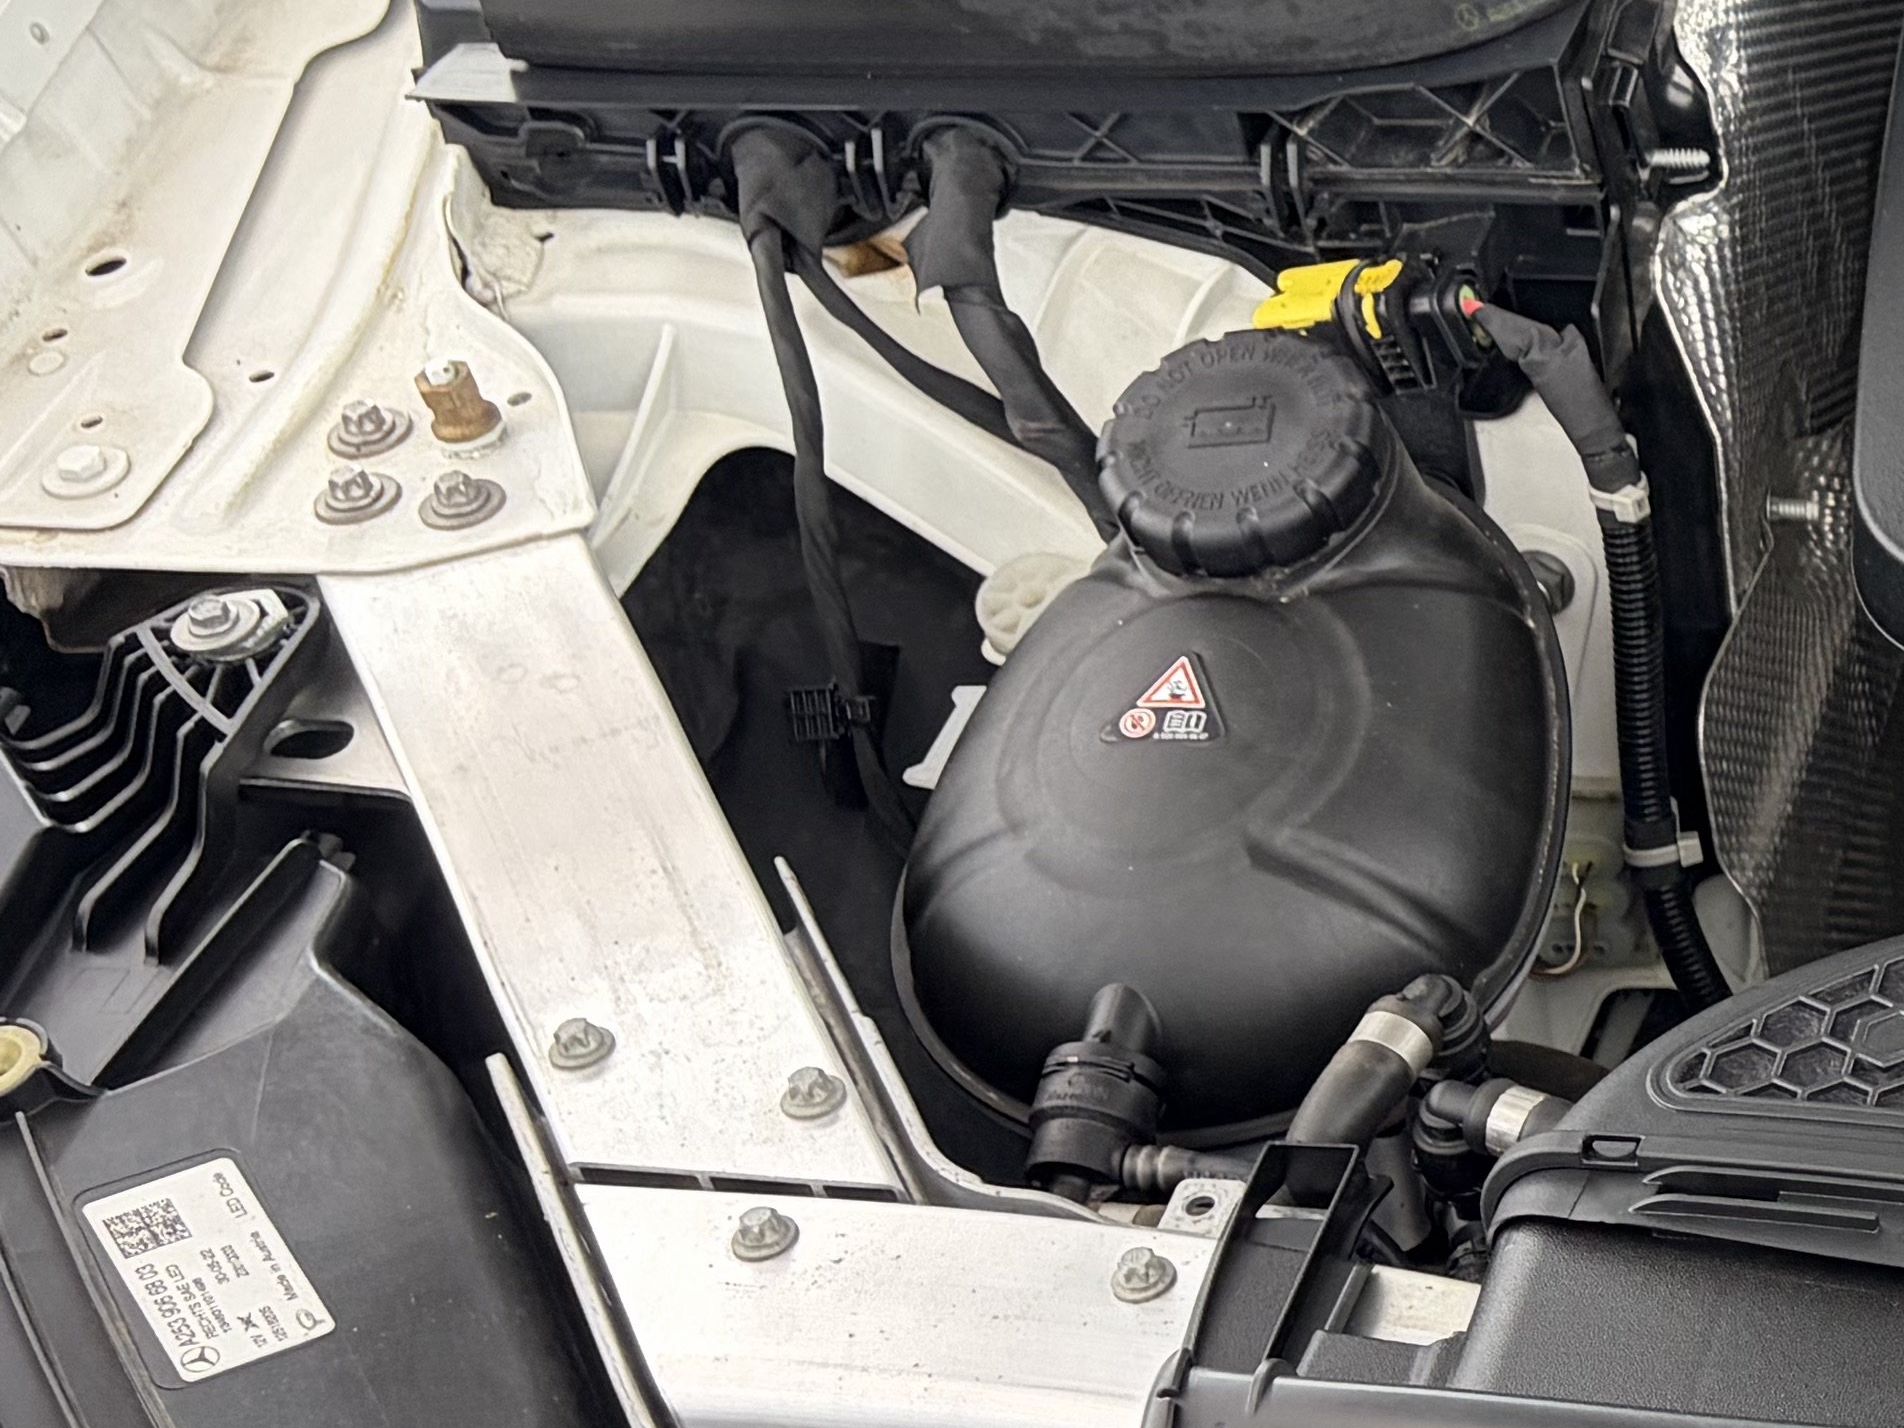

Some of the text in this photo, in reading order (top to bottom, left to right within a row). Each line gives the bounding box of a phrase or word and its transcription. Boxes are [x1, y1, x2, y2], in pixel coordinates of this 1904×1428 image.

[1134, 392, 1161, 420] DO
[1156, 362, 1192, 395] NOT
[1200, 345, 1256, 367] OPEN
[1231, 474, 1291, 507] WENN
[213, 1172, 234, 1198] Code
[226, 1198, 248, 1218] LED
[250, 1231, 298, 1301] Made in Austria
[135, 1263, 199, 1347] A253 906 68 03
[166, 1264, 219, 1340] RECHTS SAE LED
